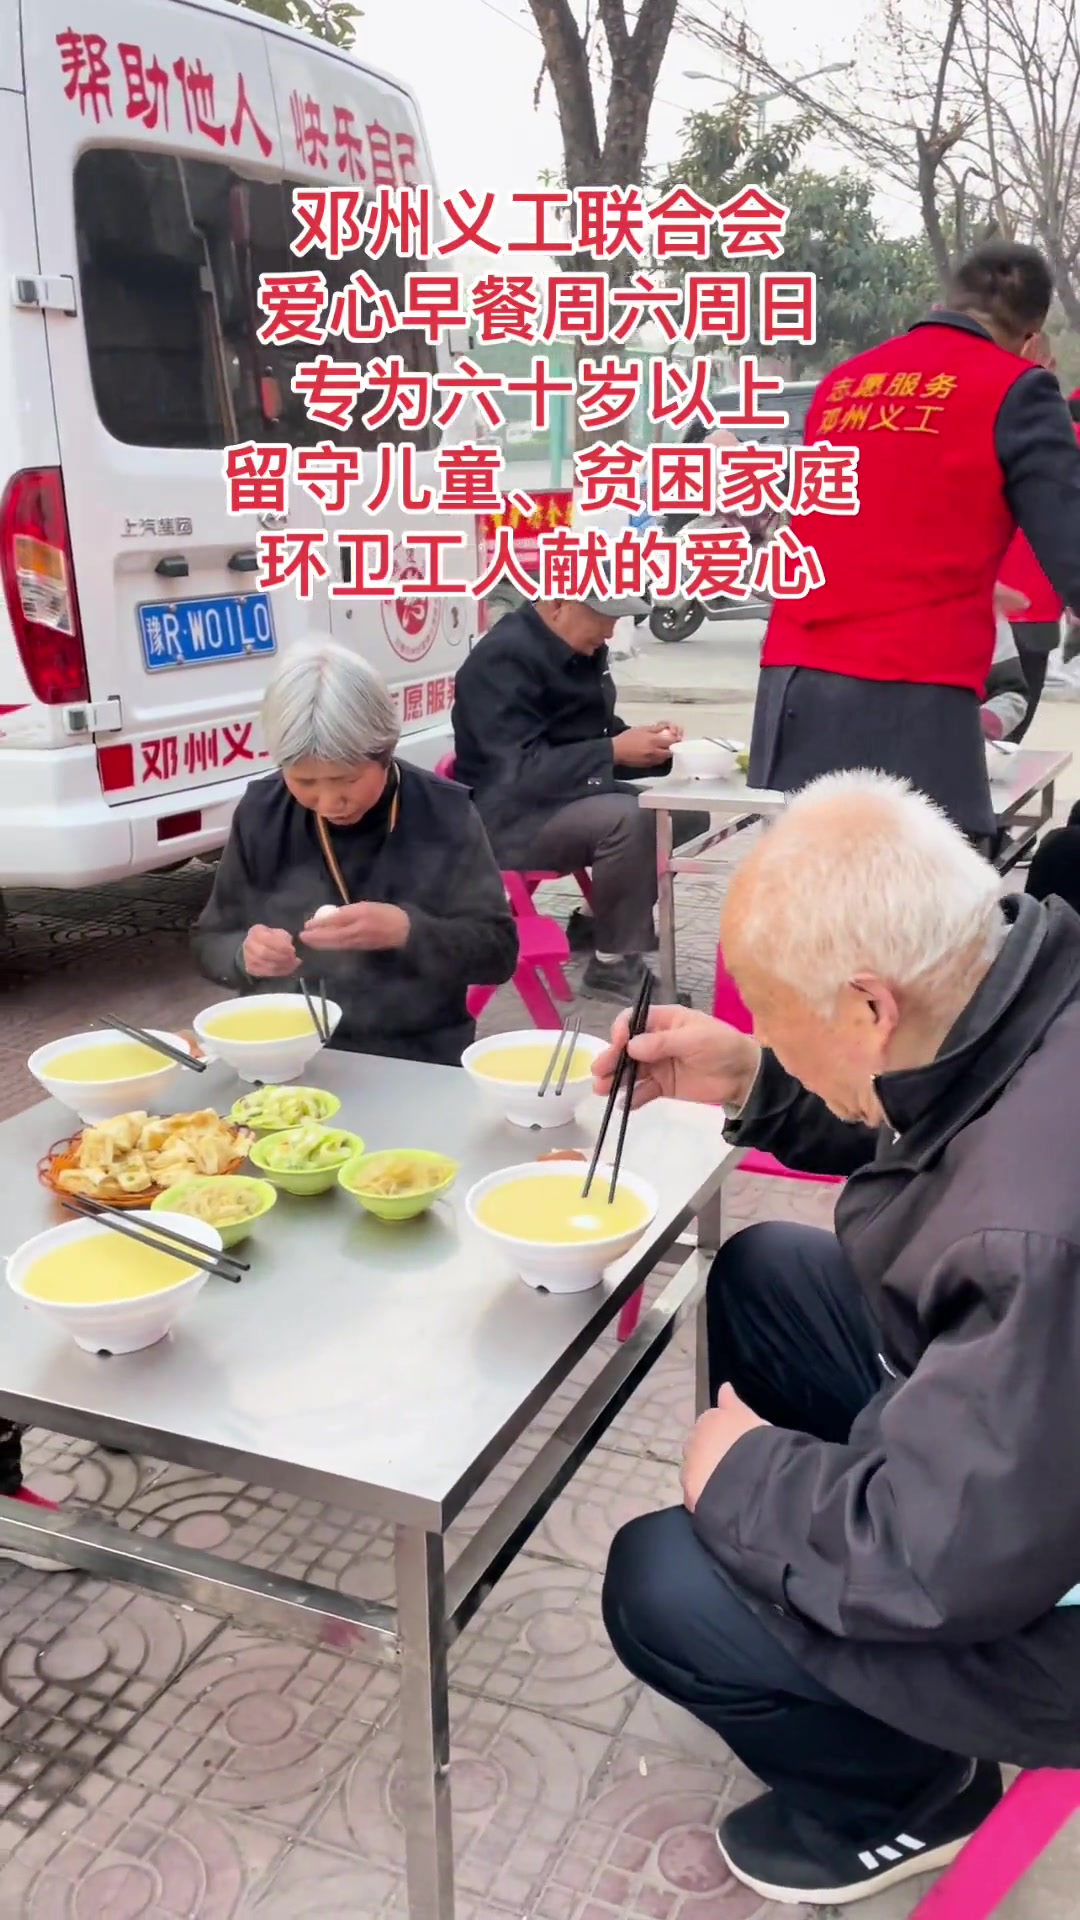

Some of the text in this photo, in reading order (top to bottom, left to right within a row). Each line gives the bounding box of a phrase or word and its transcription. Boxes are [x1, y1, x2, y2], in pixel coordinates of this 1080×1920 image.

[56, 26, 417, 189] 帮助他人 快乐自己
[826, 372, 958, 402] 志愿服务
[816, 402, 944, 435] 邓州义工
[120, 517, 193, 538] 上汽集团
[390, 676, 455, 721] 愿服
[140, 721, 270, 783] 邓州义
